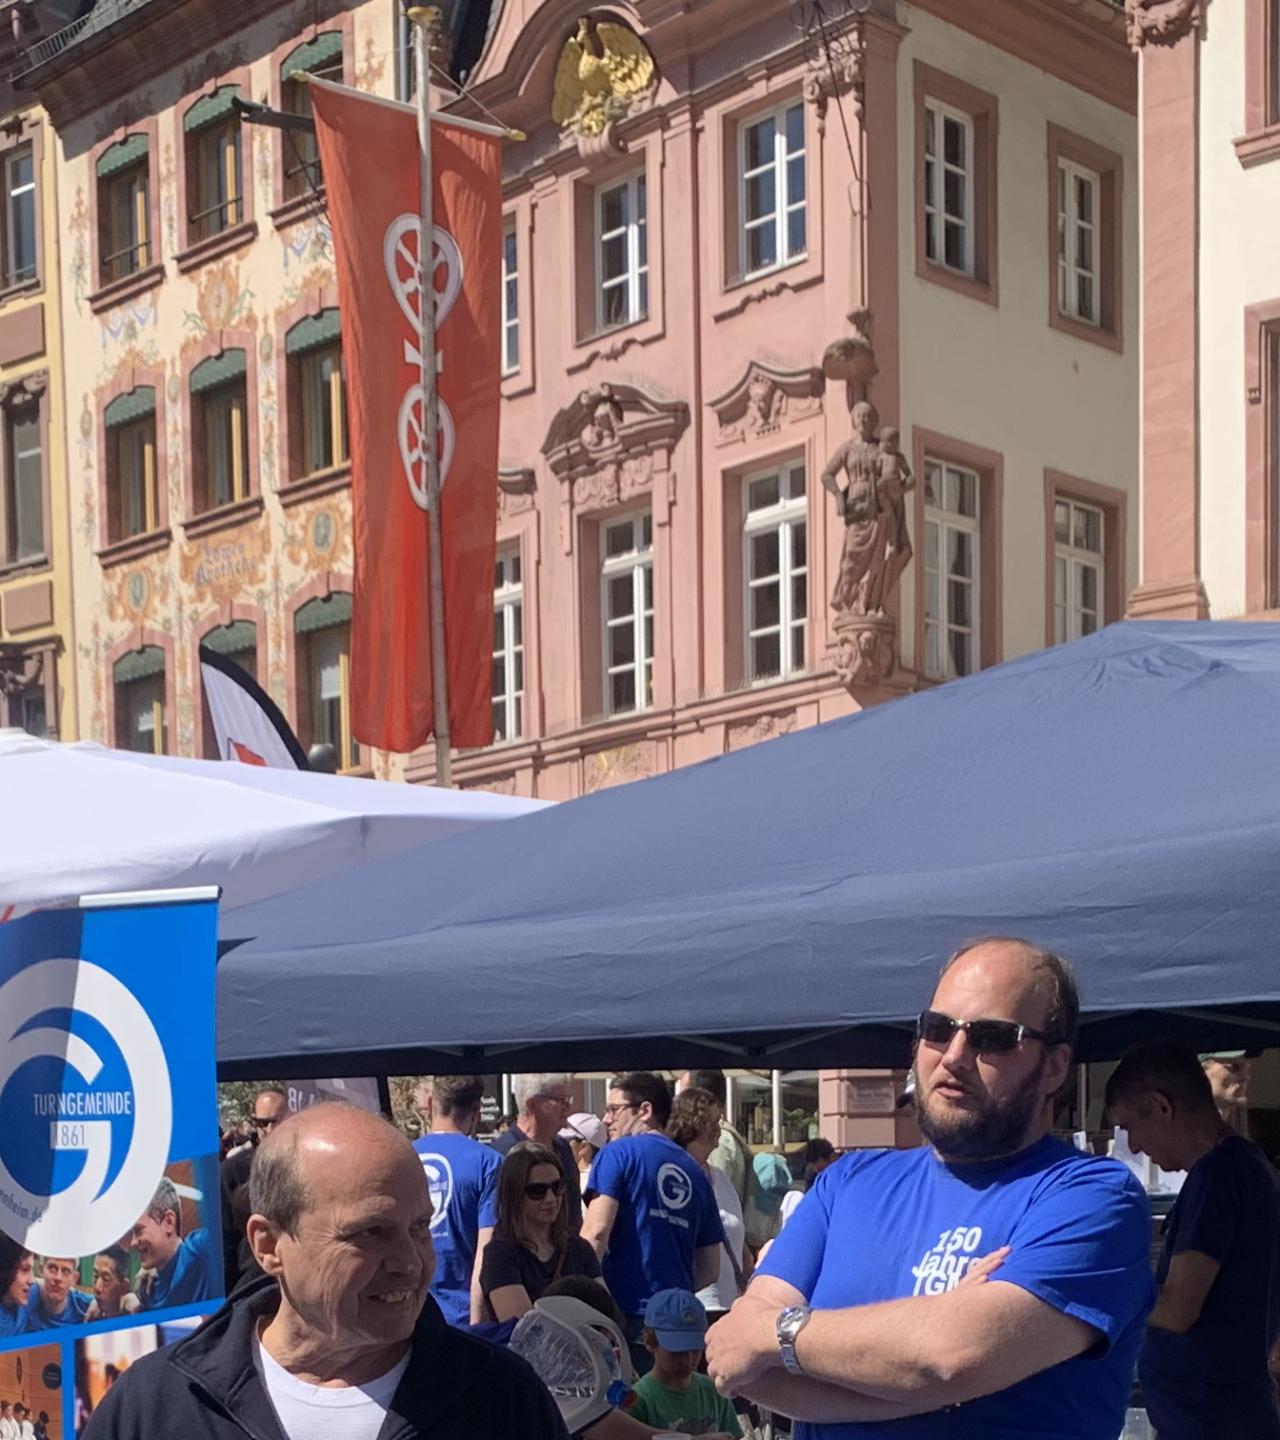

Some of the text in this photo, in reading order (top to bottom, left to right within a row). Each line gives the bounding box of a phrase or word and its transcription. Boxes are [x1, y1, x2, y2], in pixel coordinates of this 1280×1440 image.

[33, 1091, 131, 1116] TURNGEMEINDE
[53, 1124, 85, 1147] 1861
[932, 1226, 982, 1252] 150
